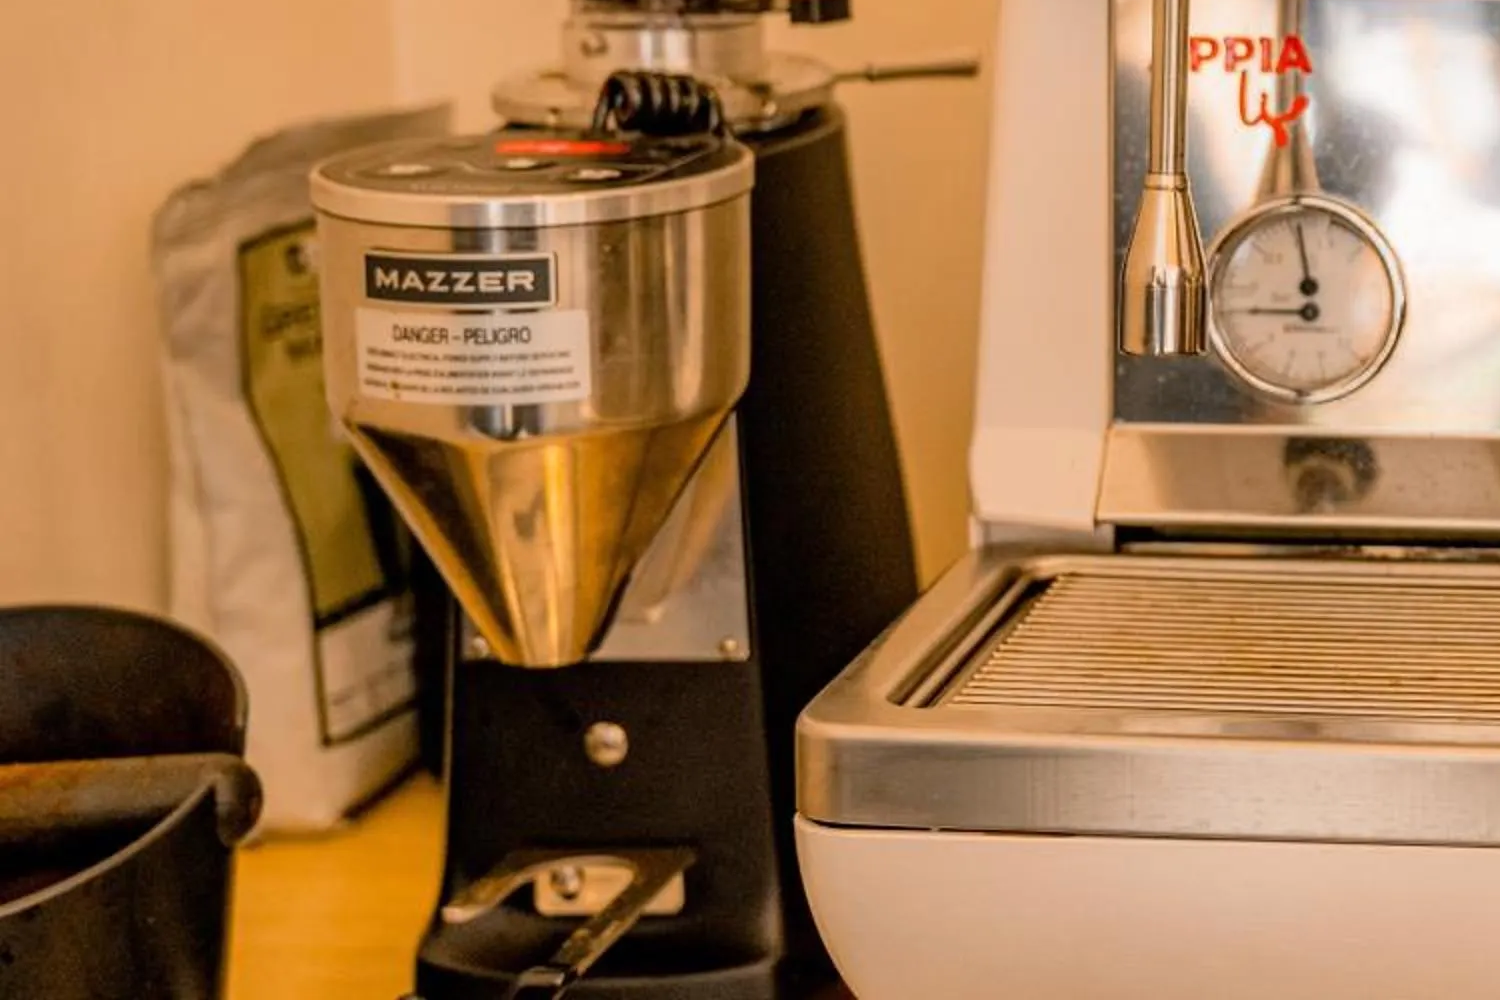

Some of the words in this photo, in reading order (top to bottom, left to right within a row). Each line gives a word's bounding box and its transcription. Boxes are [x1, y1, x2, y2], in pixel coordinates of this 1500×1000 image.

[1189, 35, 1312, 73] PPIA
[375, 266, 536, 293] MAZZER
[392, 324, 449, 344] DANGER
[463, 325, 532, 345] PELIGRO
